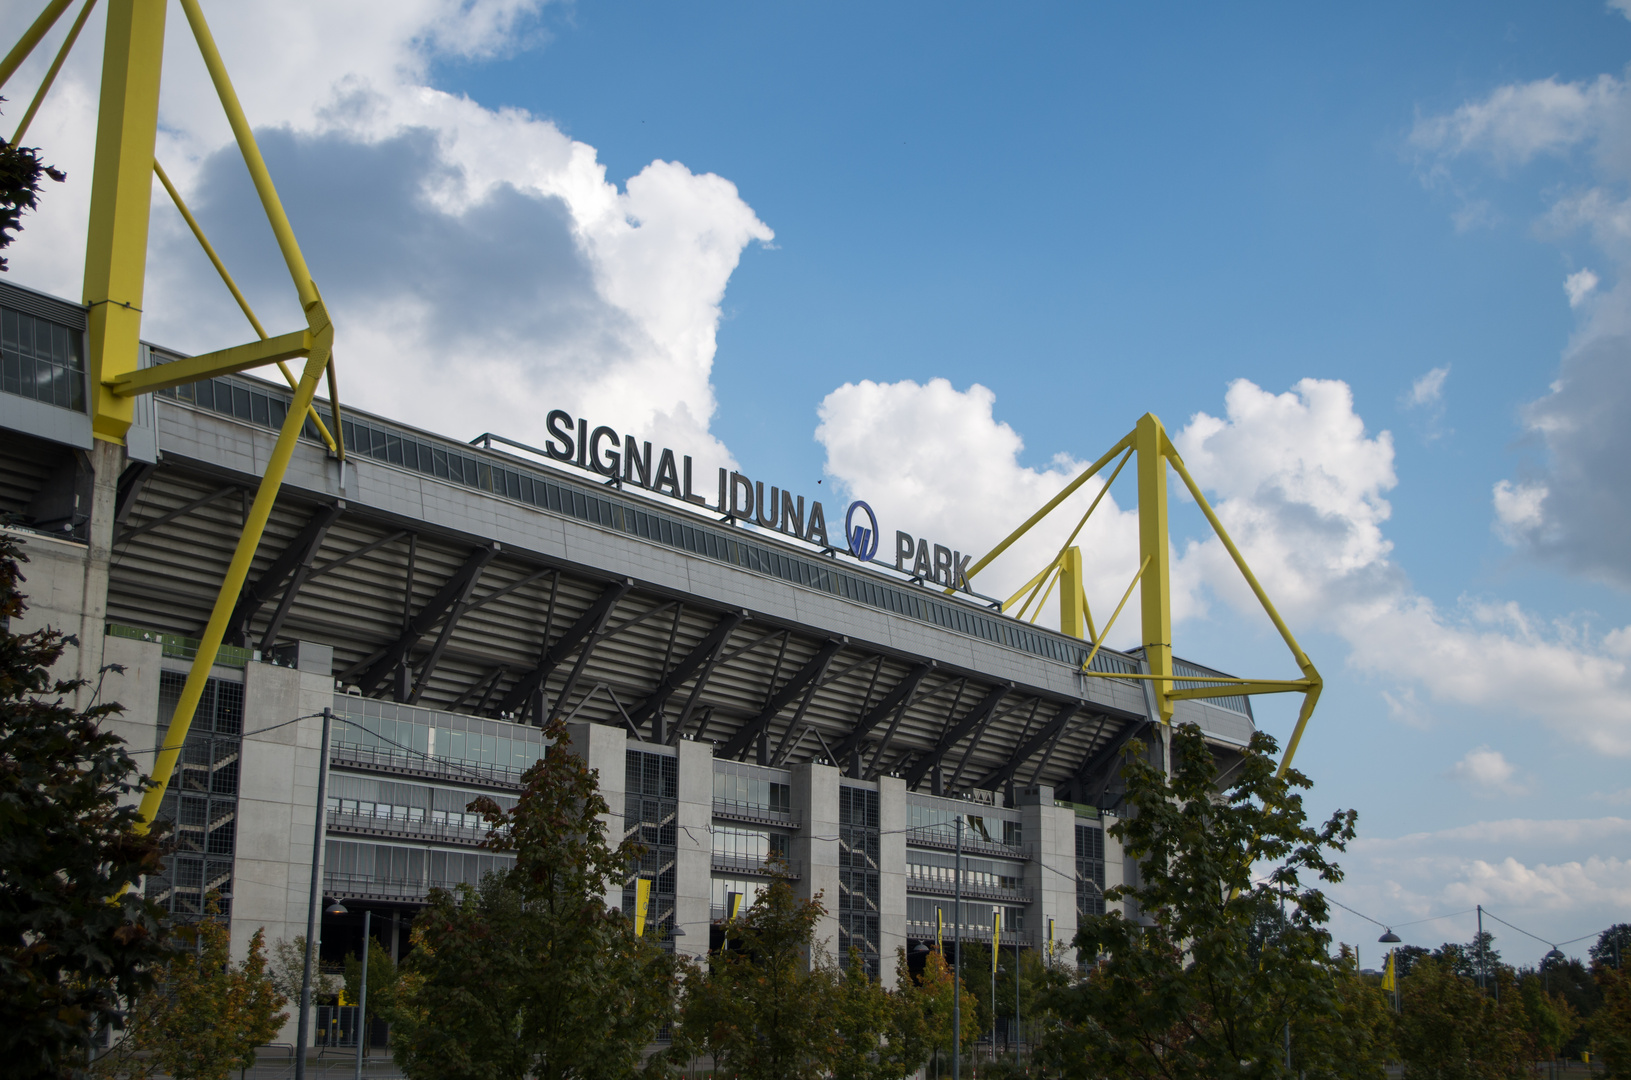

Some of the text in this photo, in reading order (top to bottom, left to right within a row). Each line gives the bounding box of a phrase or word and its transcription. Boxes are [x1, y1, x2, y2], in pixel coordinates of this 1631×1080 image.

[545, 409, 973, 593] SIGNAL IDUNA PARK
